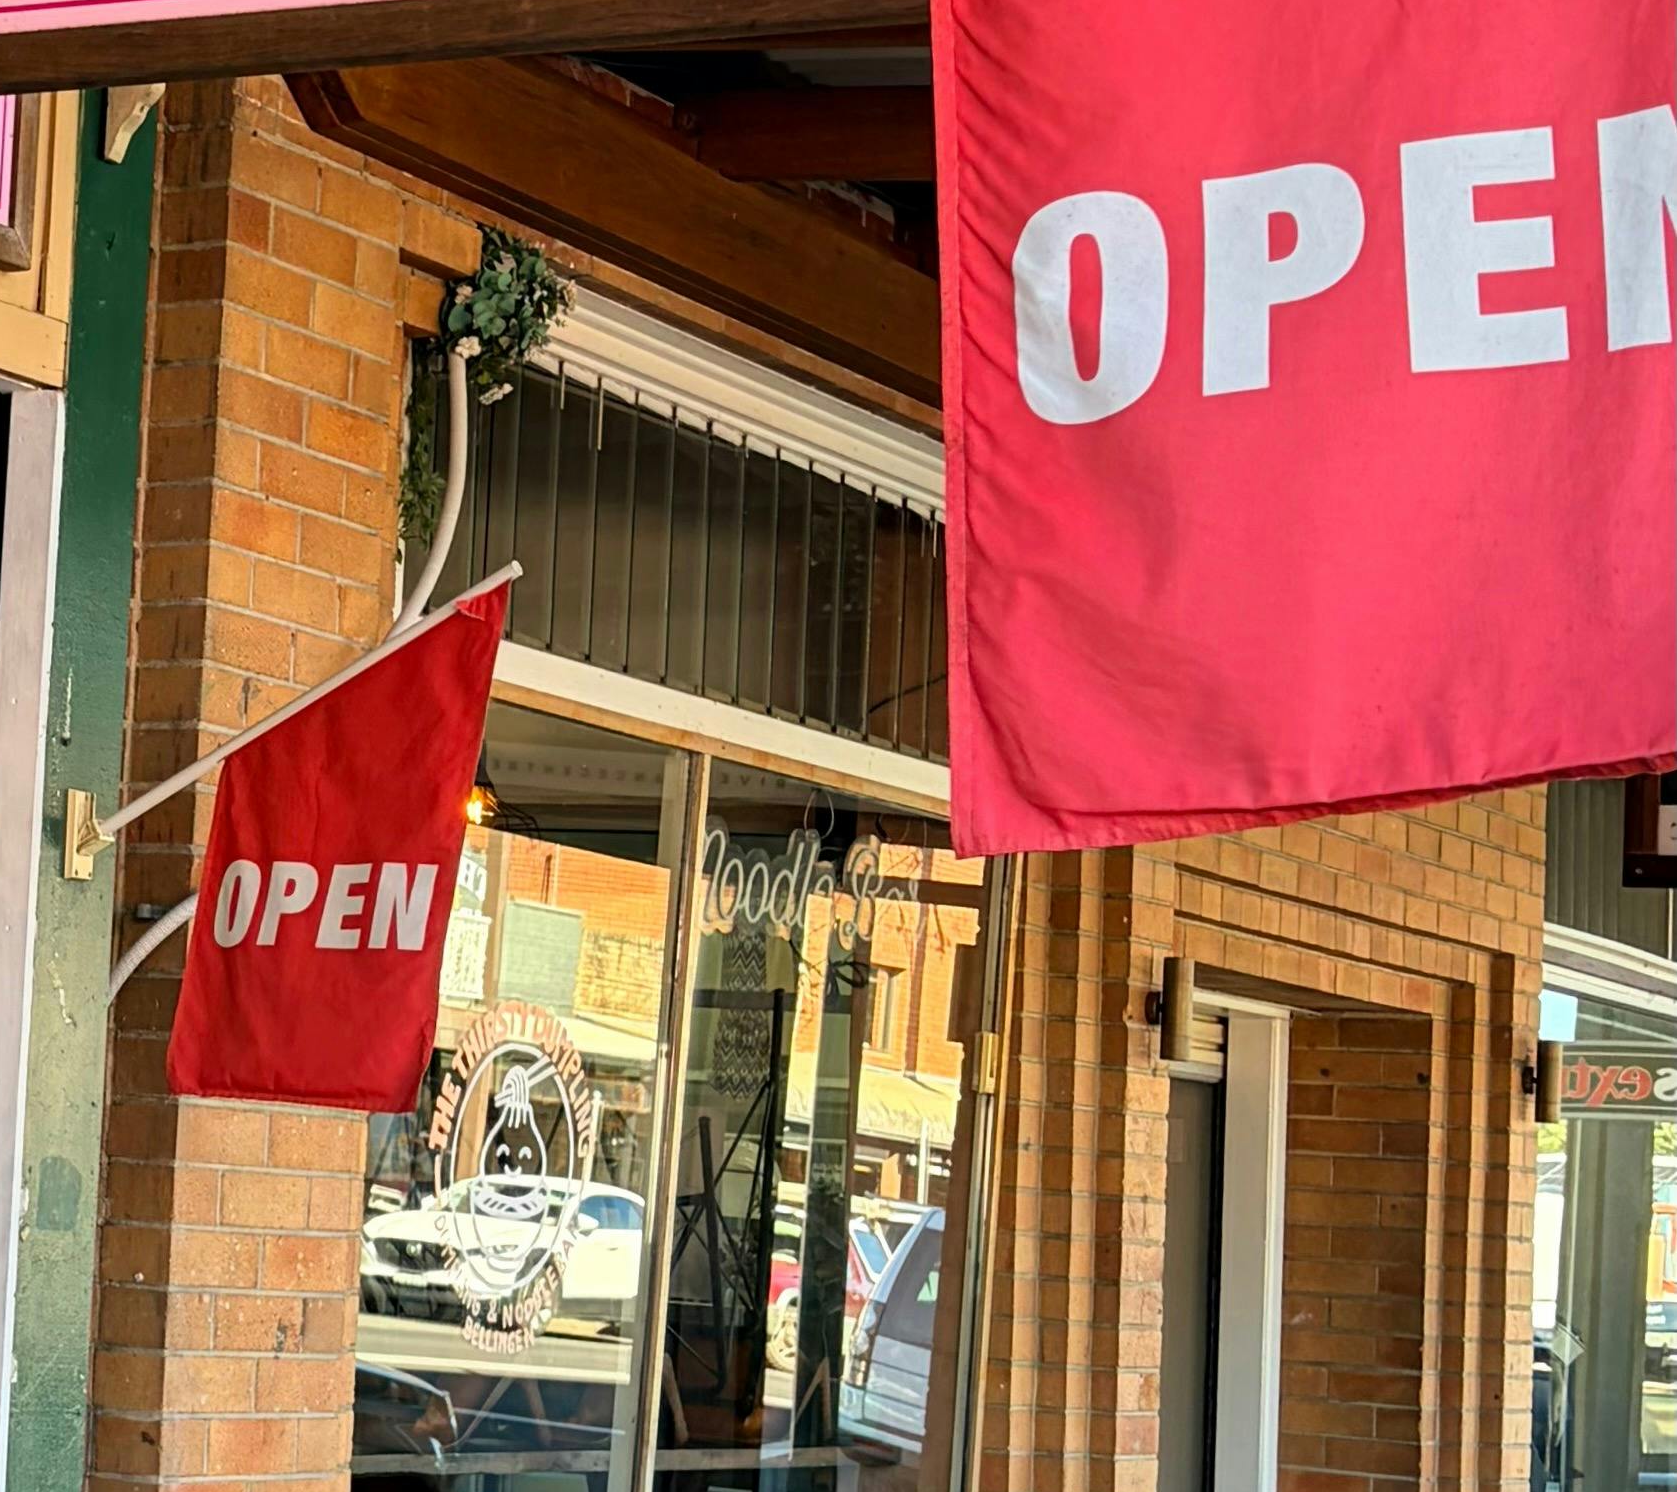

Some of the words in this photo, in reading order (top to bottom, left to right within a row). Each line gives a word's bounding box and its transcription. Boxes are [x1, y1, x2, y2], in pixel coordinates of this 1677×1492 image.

[212, 859, 439, 952] OPEN
[428, 1072, 462, 1150] THE
[452, 999, 531, 1082] THIRSTY
[532, 1003, 595, 1160] DUMPLING
[461, 1317, 535, 1356] BELLINGEN
